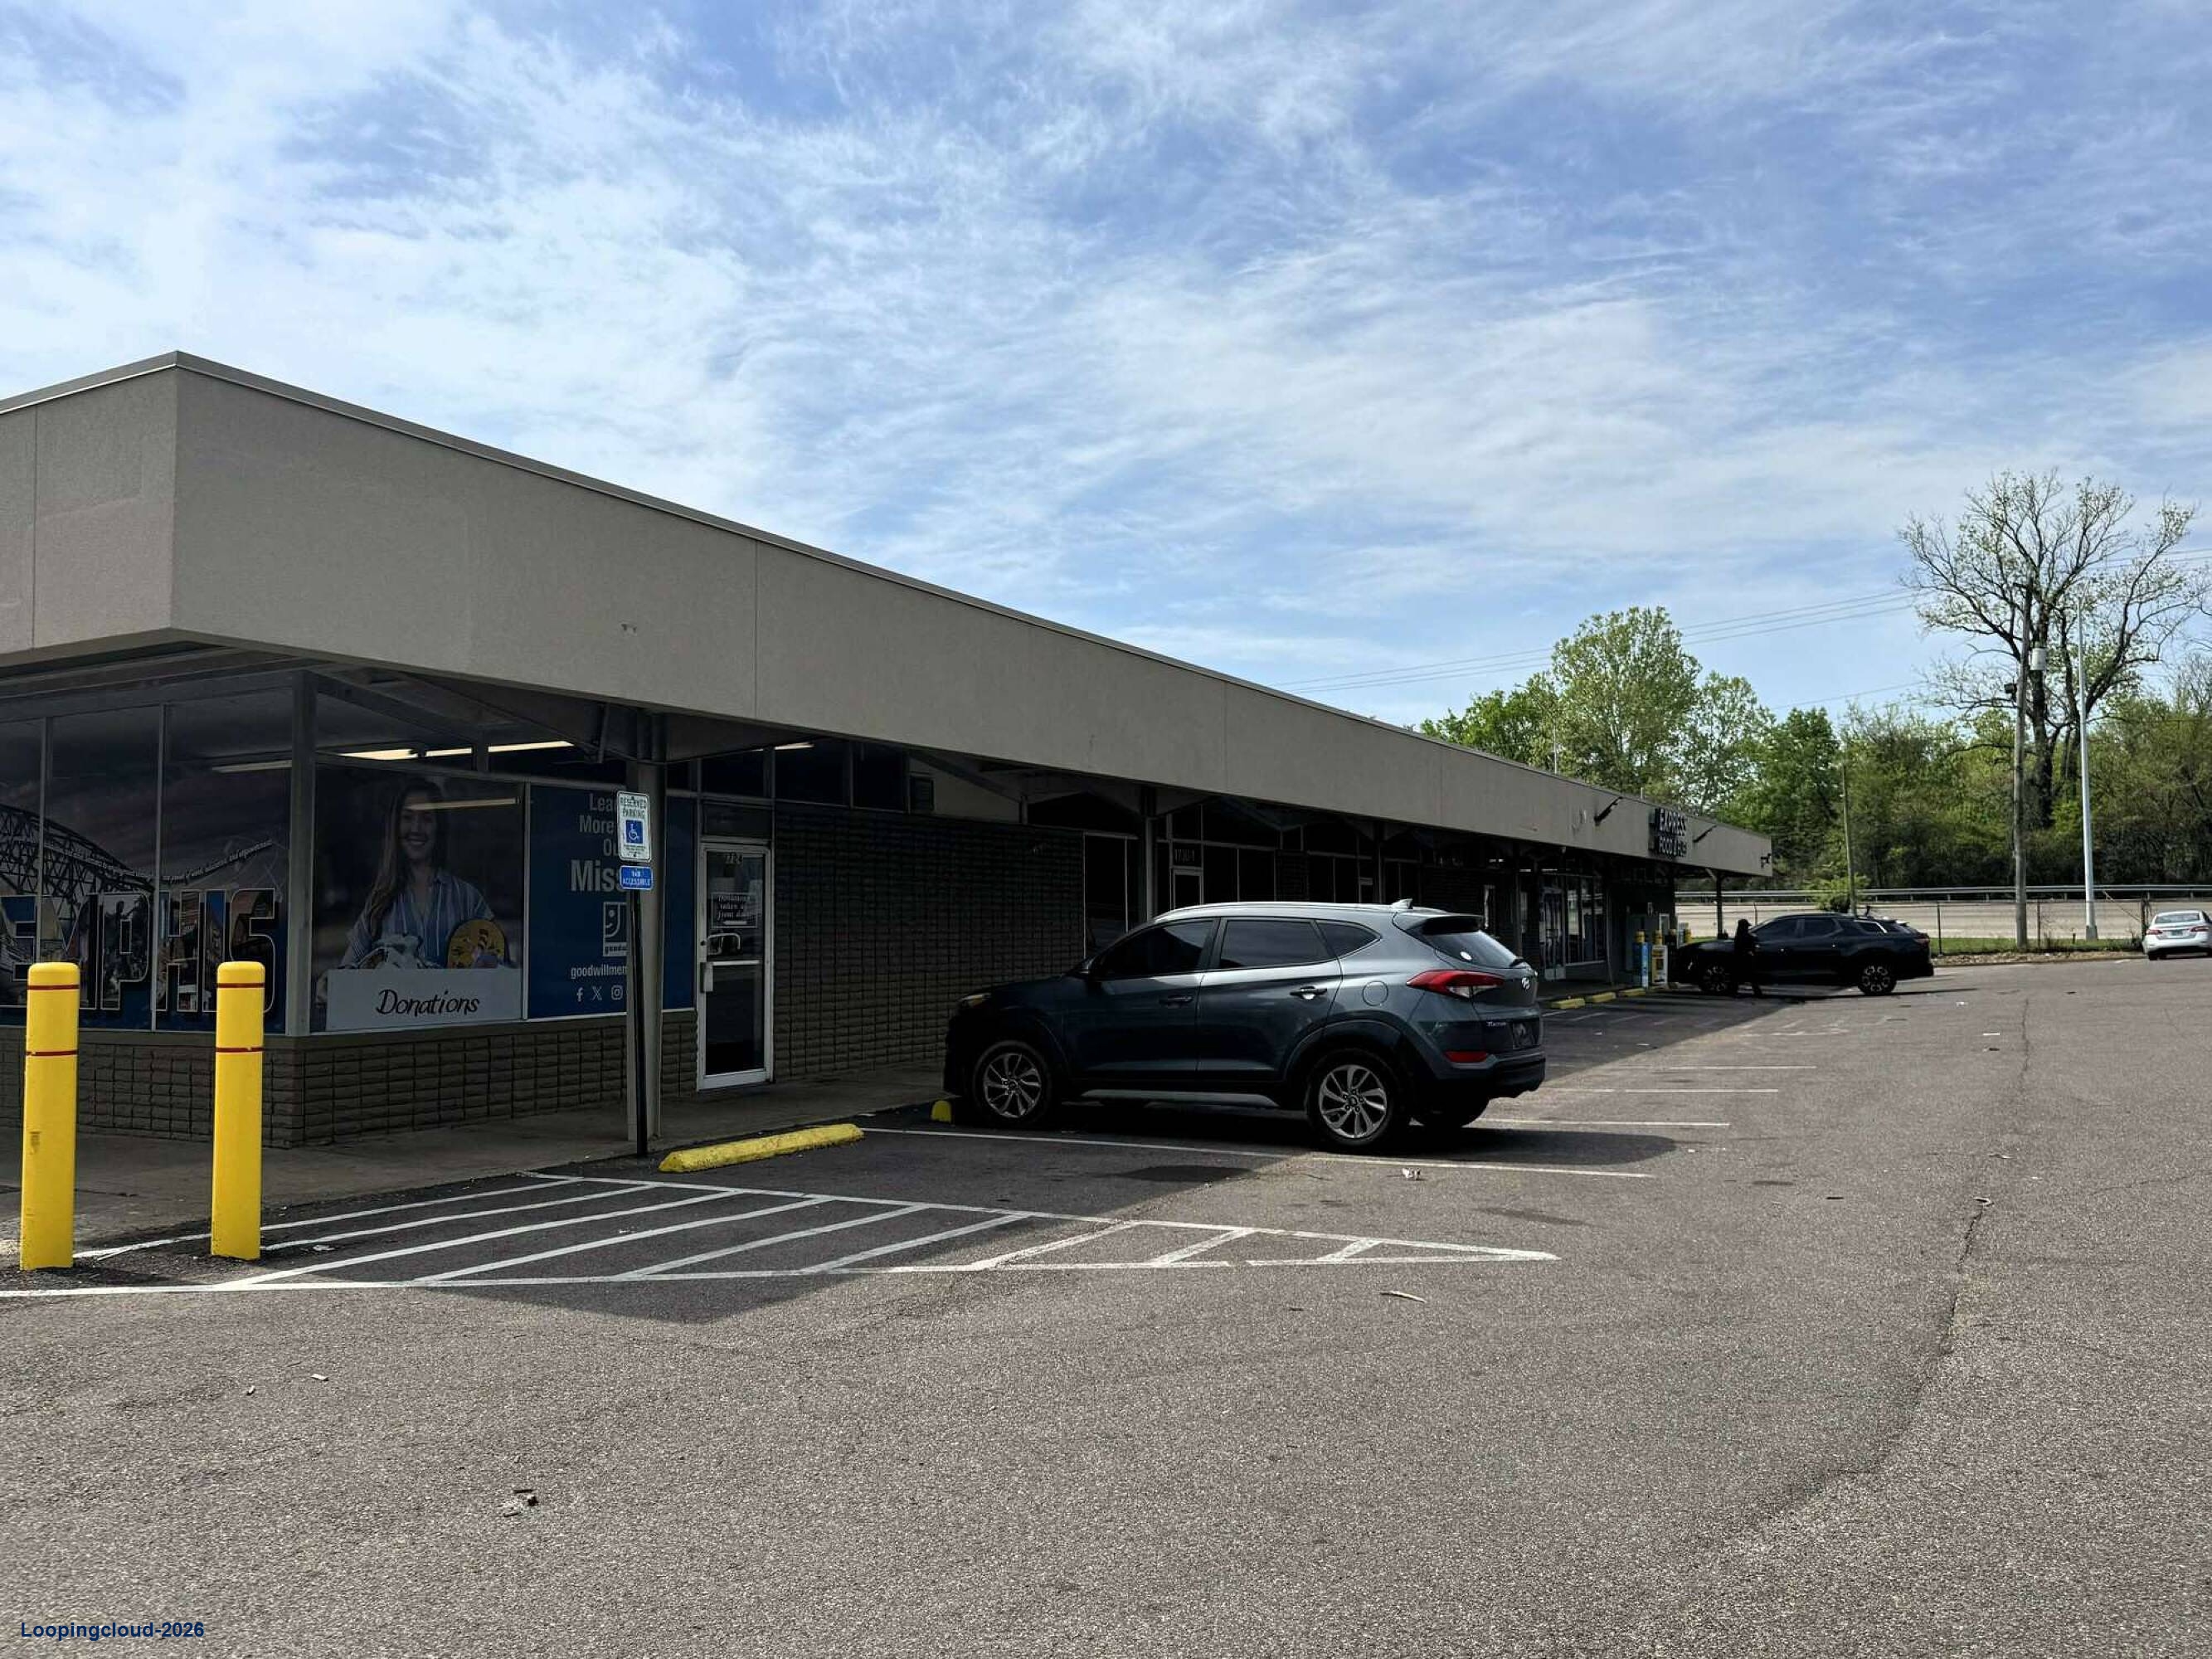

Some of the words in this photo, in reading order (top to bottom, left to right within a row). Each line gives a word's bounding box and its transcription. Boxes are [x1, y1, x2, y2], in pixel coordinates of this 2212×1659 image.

[589, 793, 617, 812] Lea
[579, 815, 615, 834] More
[375, 987, 480, 1018] Donations
